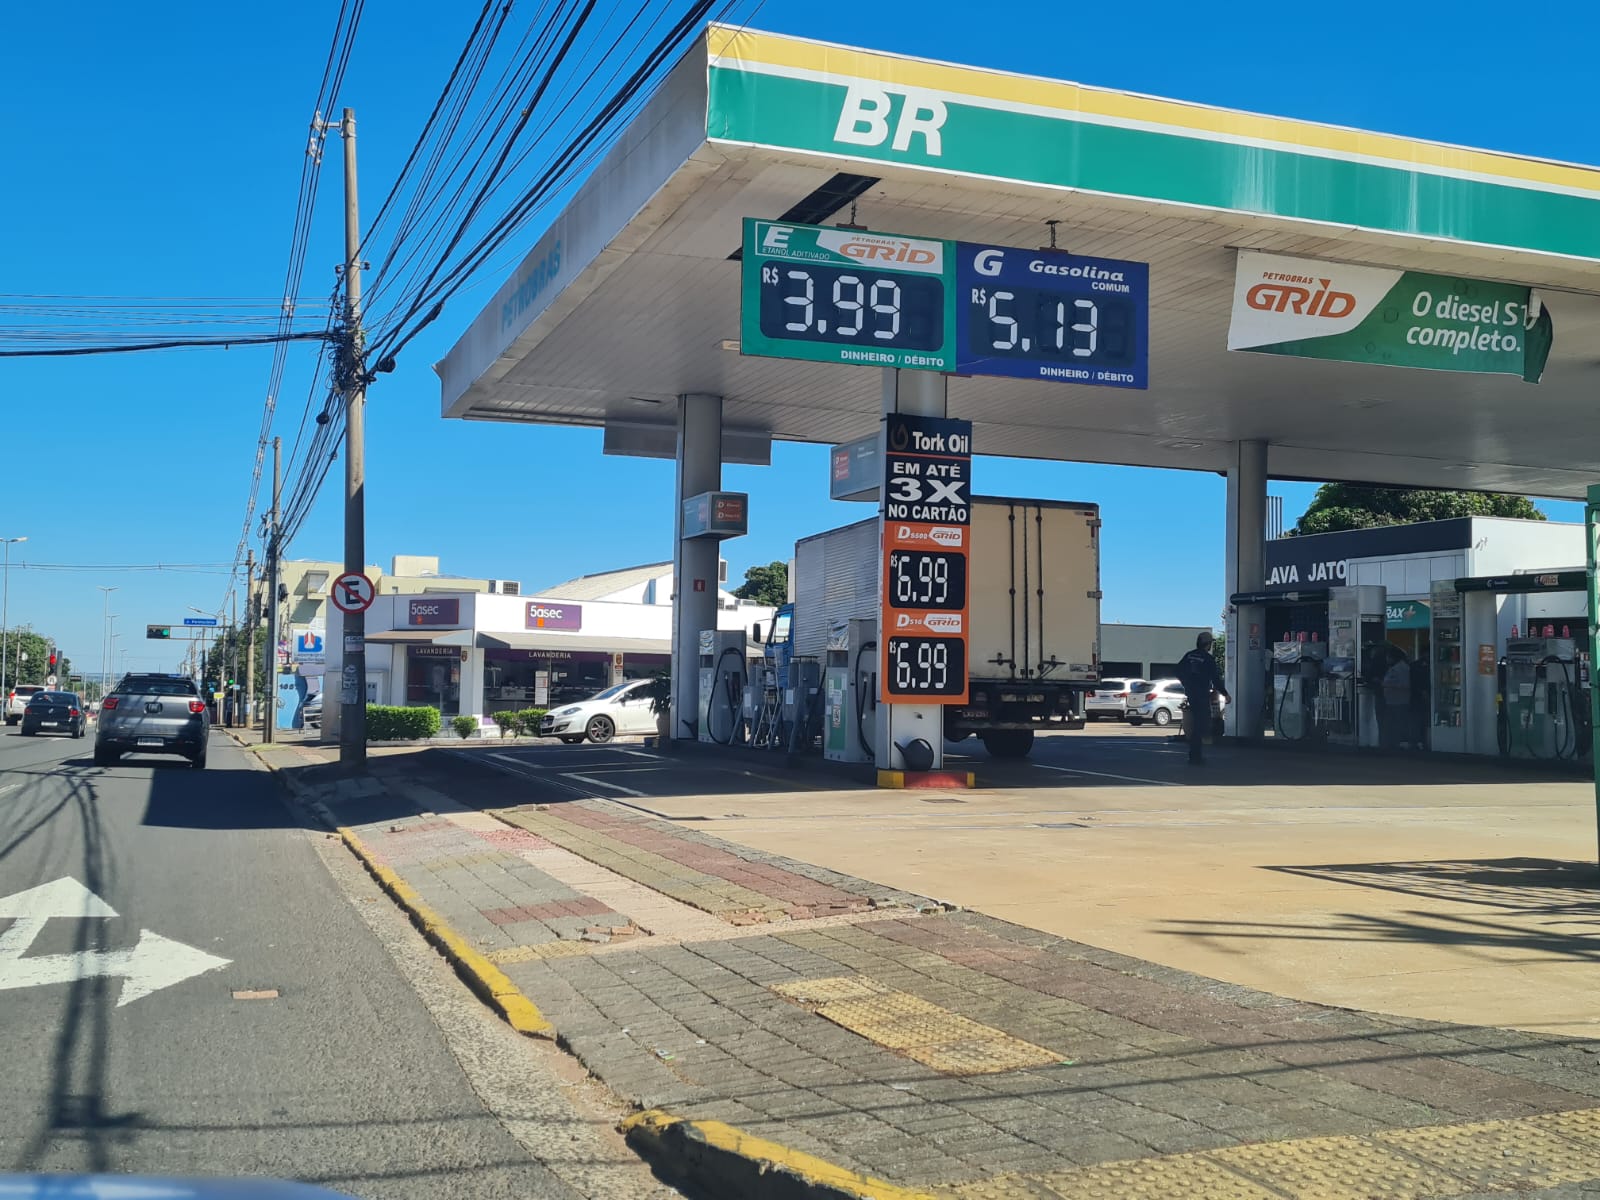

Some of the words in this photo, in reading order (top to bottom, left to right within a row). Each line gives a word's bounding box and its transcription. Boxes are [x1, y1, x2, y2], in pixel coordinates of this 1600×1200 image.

[833, 85, 948, 156] BR
[762, 225, 794, 248] E
[851, 236, 896, 246] PETROBRAS
[762, 246, 790, 257] ETANOL
[791, 250, 830, 261] ADITIVADO
[973, 249, 1005, 277] G
[1029, 260, 1125, 282] Gasolina
[762, 266, 779, 286] R$
[1262, 271, 1314, 285] PETROBRAS
[1091, 281, 1130, 293] COMUM
[971, 288, 987, 307] R$
[1412, 291, 1432, 317] O
[1435, 295, 1499, 326] diesel
[1406, 325, 1521, 355] completo.
[840, 350, 895, 363] DINHEIRO
[904, 353, 945, 367] DÉBITO
[1039, 366, 1089, 379] DINHEIRO
[1097, 370, 1134, 383] DÉBITO
[912, 431, 945, 452] Tork
[948, 433, 969, 453] Oil
[893, 461, 920, 475] EM
[926, 463, 961, 478] ATÉ
[888, 504, 908, 518] NO
[912, 504, 967, 522] CARTÃO
[1308, 559, 1347, 582] JATO
[411, 603, 439, 615] 5asec
[530, 605, 563, 619] 5asec
[415, 647, 453, 655] LAVANDERIA
[529, 651, 572, 659] LAVANDERIA
